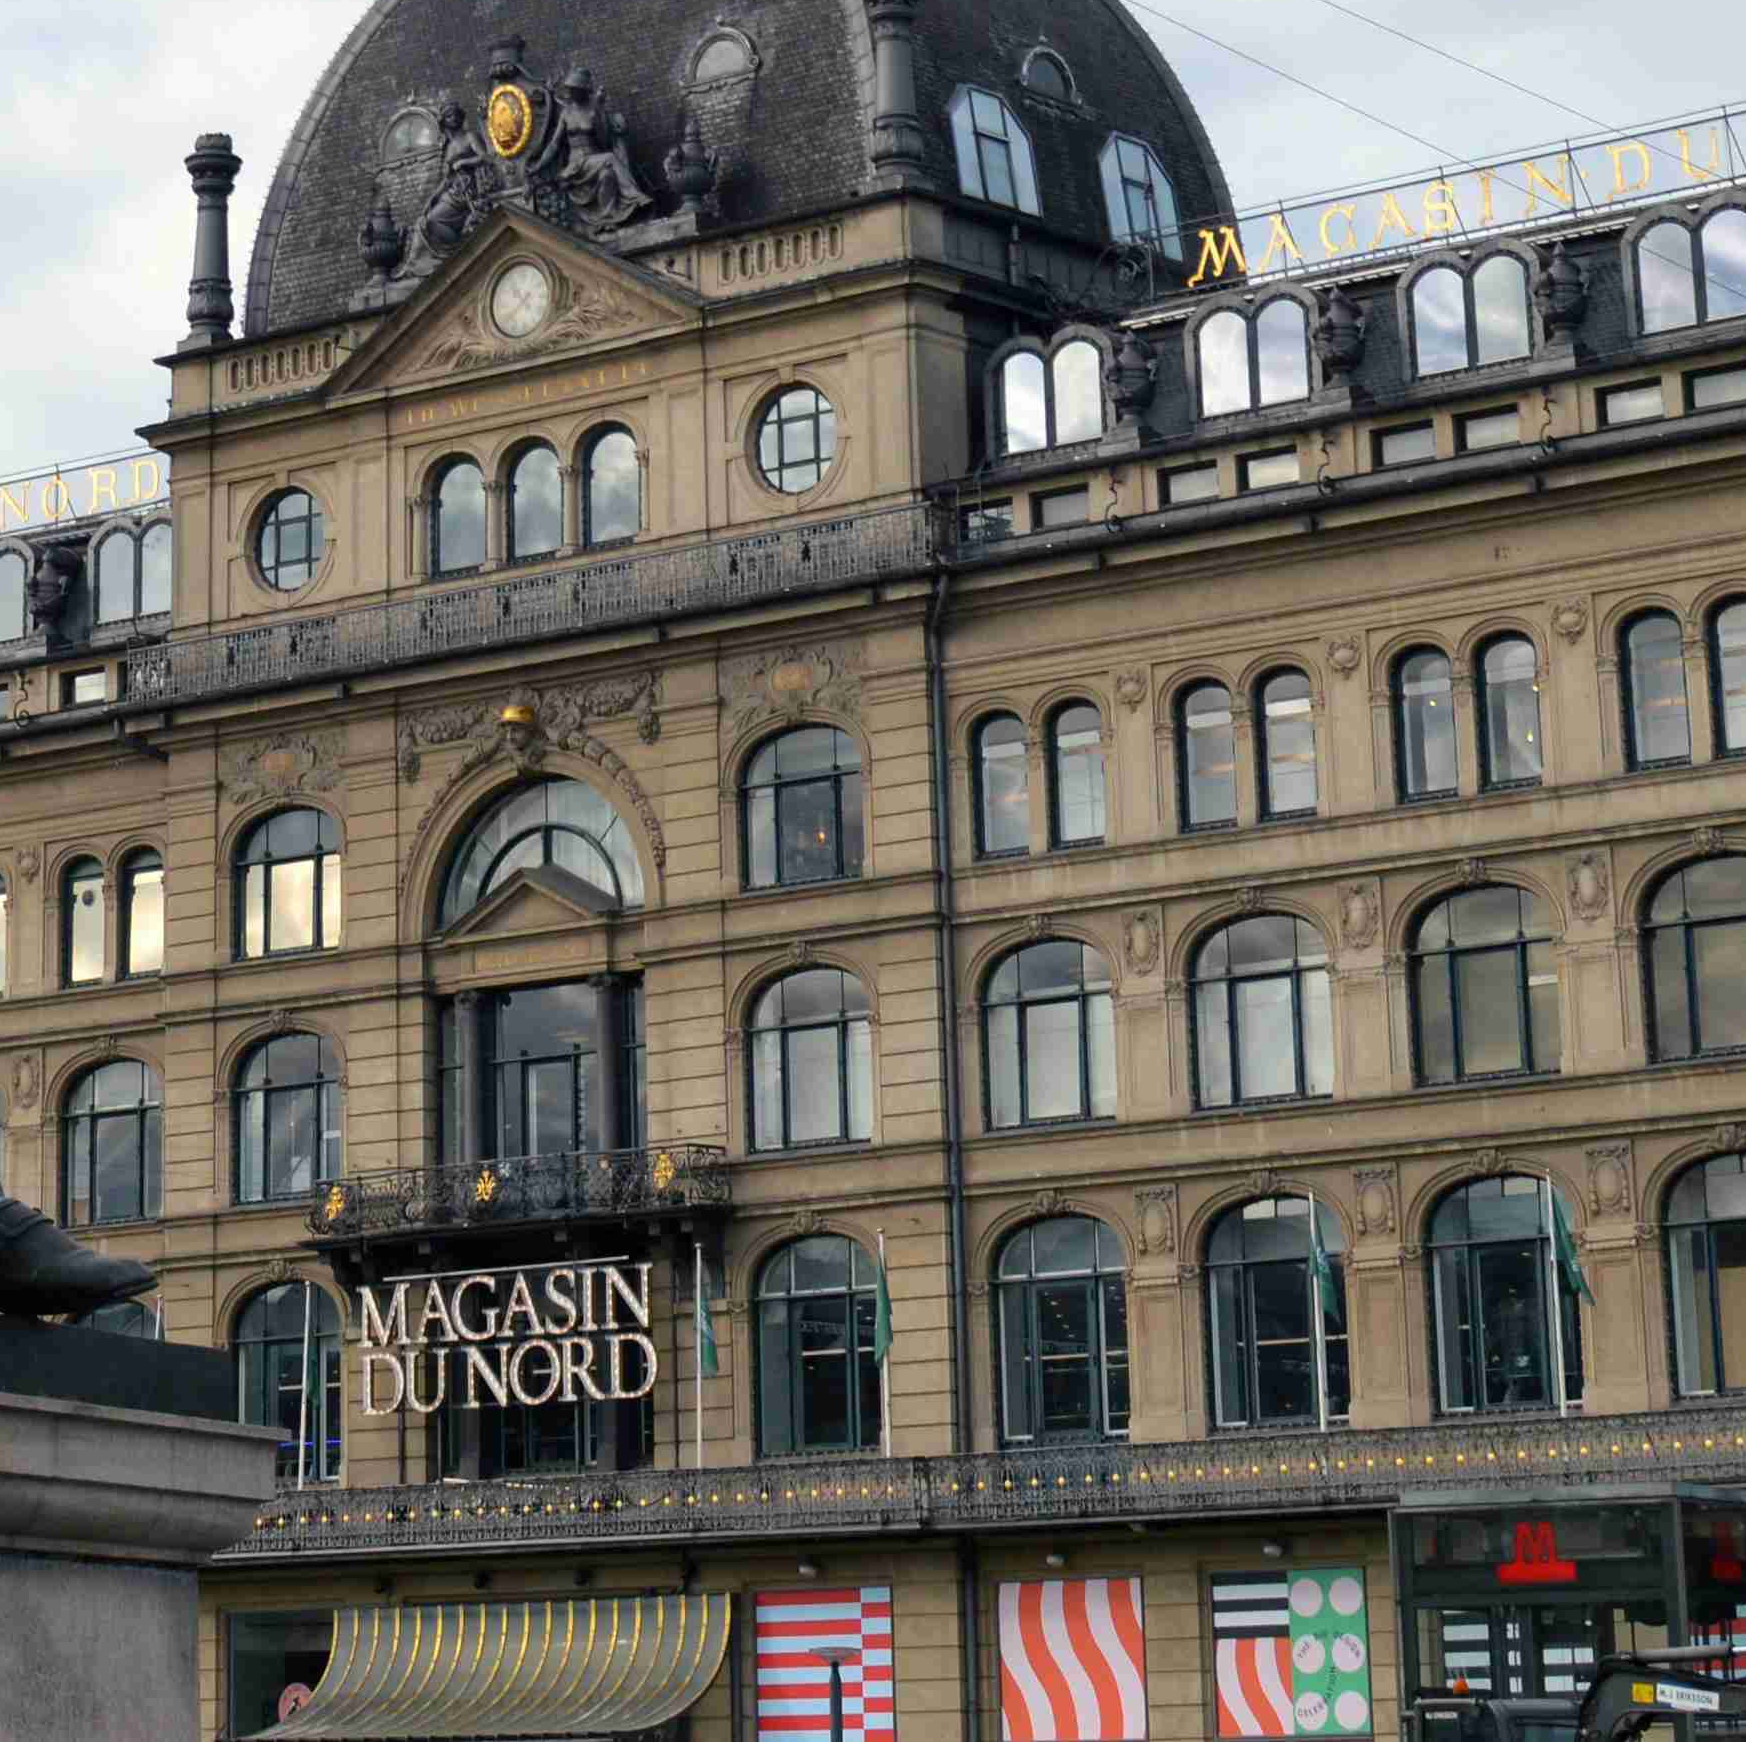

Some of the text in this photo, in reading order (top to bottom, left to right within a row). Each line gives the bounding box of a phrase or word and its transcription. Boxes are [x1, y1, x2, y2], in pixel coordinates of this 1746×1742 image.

[1186, 153, 1574, 288] MAGASIN
[1606, 127, 1720, 202] DU
[356, 1262, 653, 1348] MAGASIN
[362, 1332, 658, 1416] DU NORD
